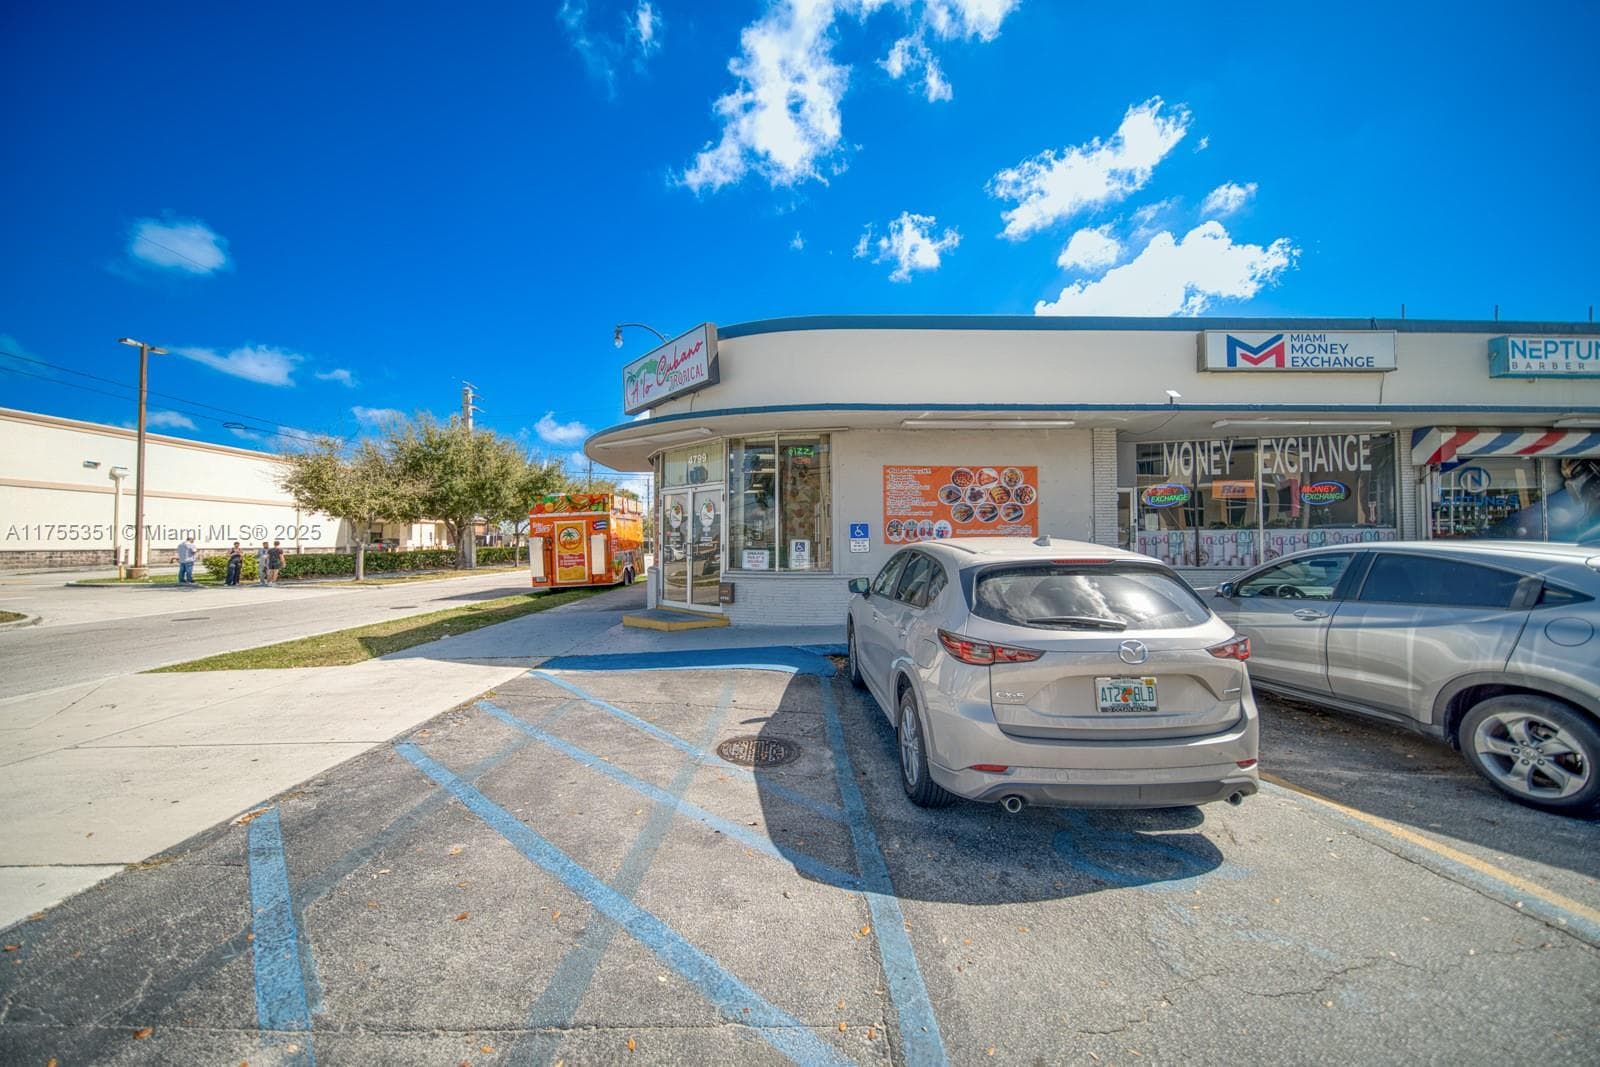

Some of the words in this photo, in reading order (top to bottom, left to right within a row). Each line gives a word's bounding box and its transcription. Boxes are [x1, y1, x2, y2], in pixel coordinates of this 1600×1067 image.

[1290, 333, 1327, 343] MIAMI
[1290, 343, 1349, 355] MONEY
[656, 340, 703, 387] Cubano
[1290, 356, 1375, 368] EXCHANGE
[1511, 361, 1586, 370] BARBER
[669, 363, 704, 387] TROPICAL
[688, 454, 707, 465] 4799
[1163, 440, 1234, 476] MONEY
[1260, 435, 1372, 475] EXCHANGE
[1146, 487, 1178, 496] MONEY
[1301, 485, 1337, 494] MONEY
[1152, 494, 1189, 502] EXCHANGE
[1304, 492, 1346, 500] EXCHANGE
[1101, 686, 1120, 702] AT2
